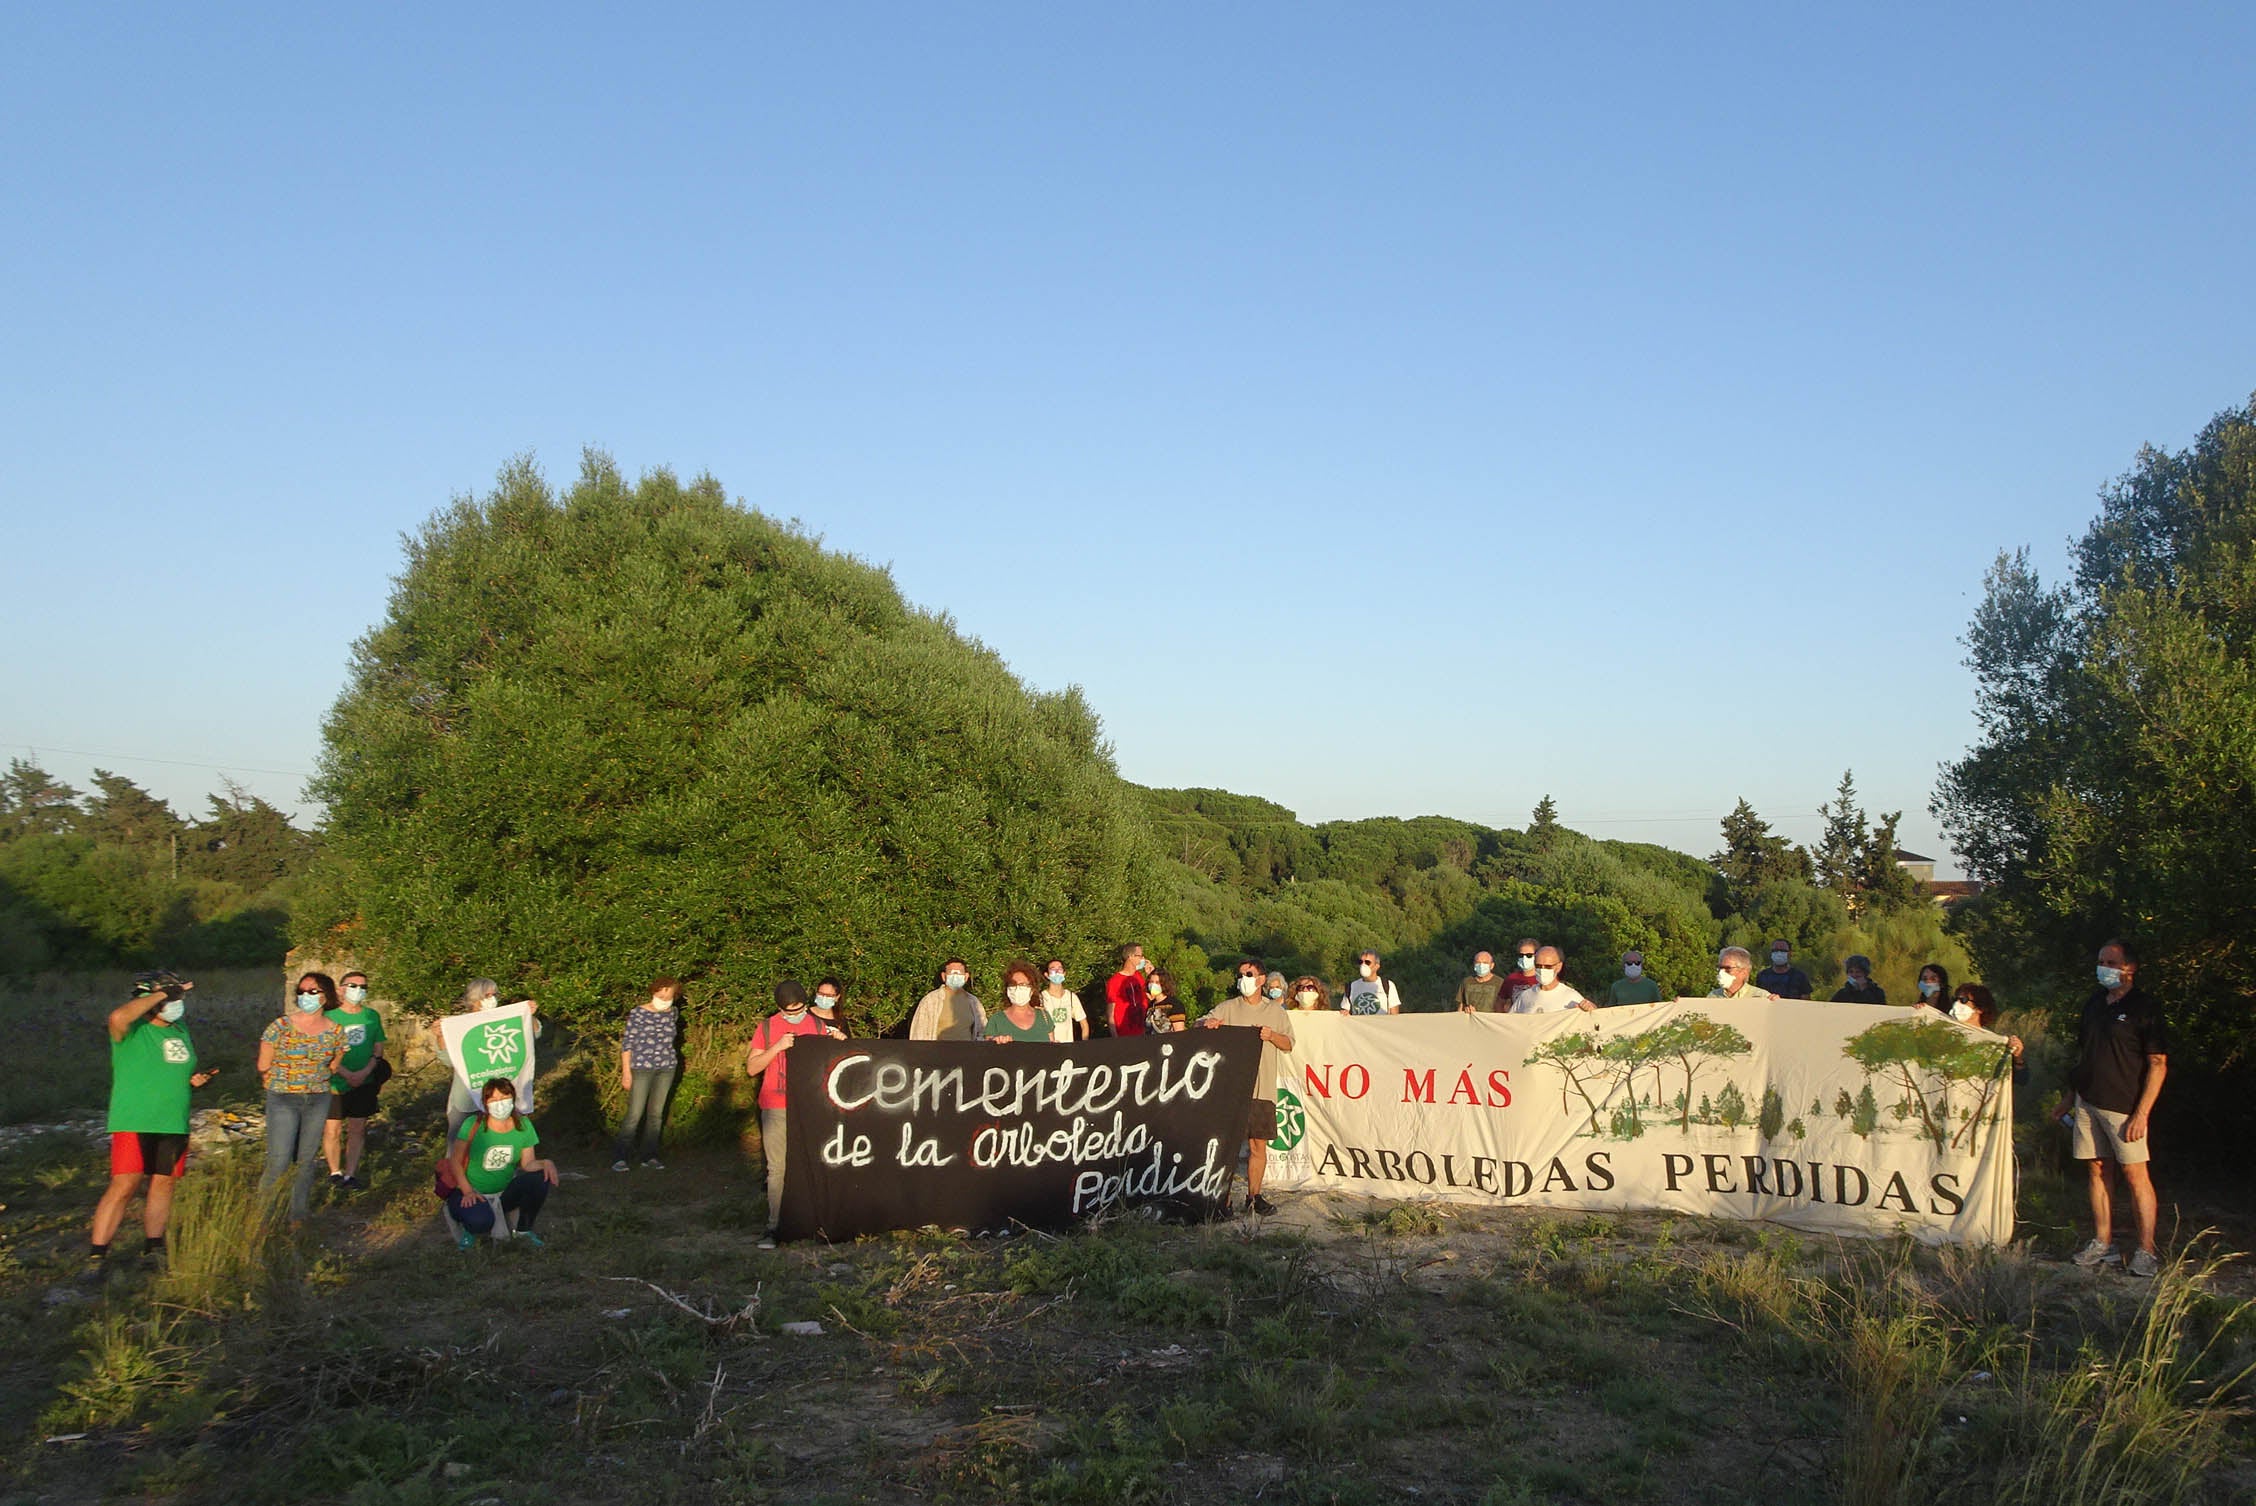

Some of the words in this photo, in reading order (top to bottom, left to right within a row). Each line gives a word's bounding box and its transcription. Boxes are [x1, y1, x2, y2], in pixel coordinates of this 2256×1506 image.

[827, 1043, 1222, 1117] Cementerio
[1304, 1063, 1371, 1100] NO
[1400, 1062, 1513, 1109] MÁS
[822, 1124, 873, 1167] de
[897, 1122, 955, 1166] la
[1318, 1143, 1616, 1198] ARBOLEDAS
[1662, 1153, 1963, 1216] PERDIDAS
